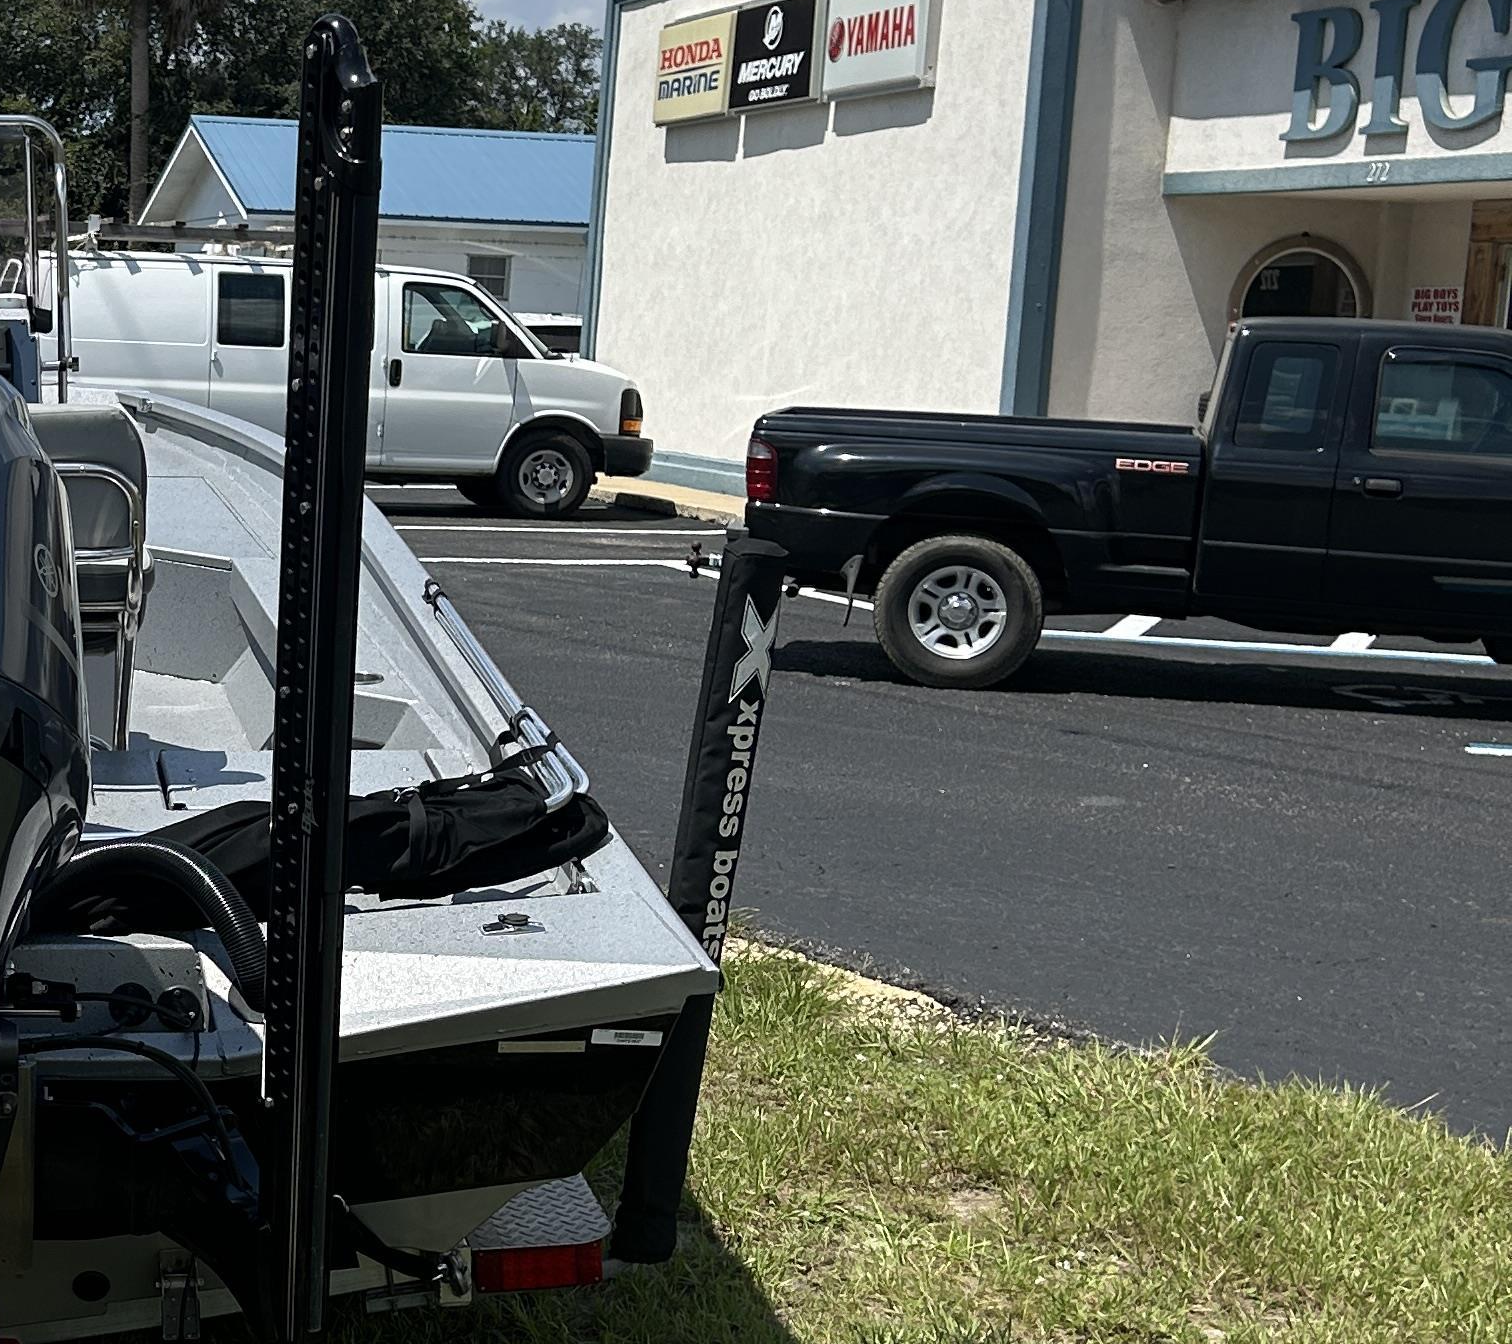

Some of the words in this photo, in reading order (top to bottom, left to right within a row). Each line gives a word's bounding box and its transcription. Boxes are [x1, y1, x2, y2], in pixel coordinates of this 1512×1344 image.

[846, 4, 916, 57] YAMAHA
[659, 37, 723, 71] HONDA
[737, 51, 805, 84] MERCURY
[657, 69, 721, 101] MARINE
[1366, 162, 1390, 182] 272
[1411, 301, 1434, 313] PLAY
[1435, 301, 1460, 313] TOYS
[1414, 288, 1431, 300] BIG
[1433, 288, 1459, 300] BOYS
[1115, 458, 1189, 474] EDGE
[718, 698, 760, 839] xpress
